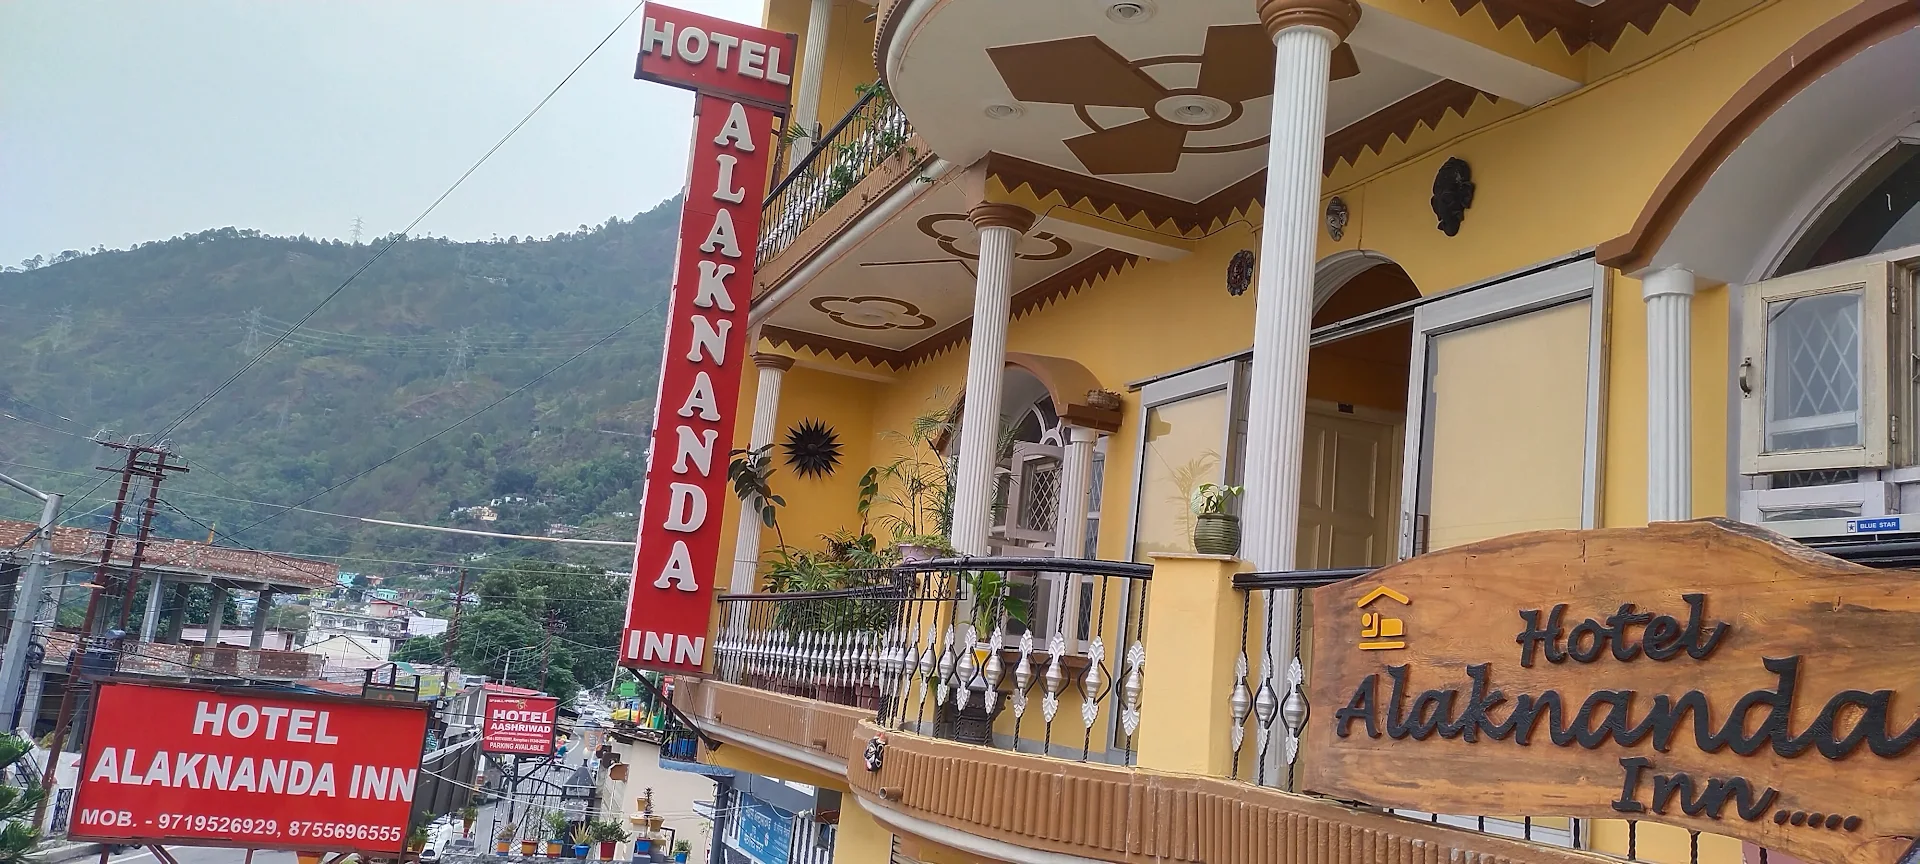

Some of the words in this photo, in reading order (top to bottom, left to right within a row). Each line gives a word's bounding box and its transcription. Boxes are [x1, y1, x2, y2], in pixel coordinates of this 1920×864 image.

[641, 16, 791, 86] HOTEL
[653, 101, 756, 593] ALAKNANDA
[627, 629, 705, 667] INN
[1515, 592, 1731, 668] Hotel
[192, 701, 339, 745] HOTEL
[490, 722, 551, 734] AASHRIWAD
[493, 709, 552, 724] HOTEL
[1335, 655, 1920, 760] Alaknanda
[489, 741, 514, 750] PARKING
[514, 742, 545, 751] AVAILABLE
[89, 747, 336, 798] ALAKNANDA
[348, 764, 418, 803] INN
[80, 808, 138, 828] MOB.
[158, 813, 282, 838] 9719526929,
[288, 820, 402, 842] 8755696555
